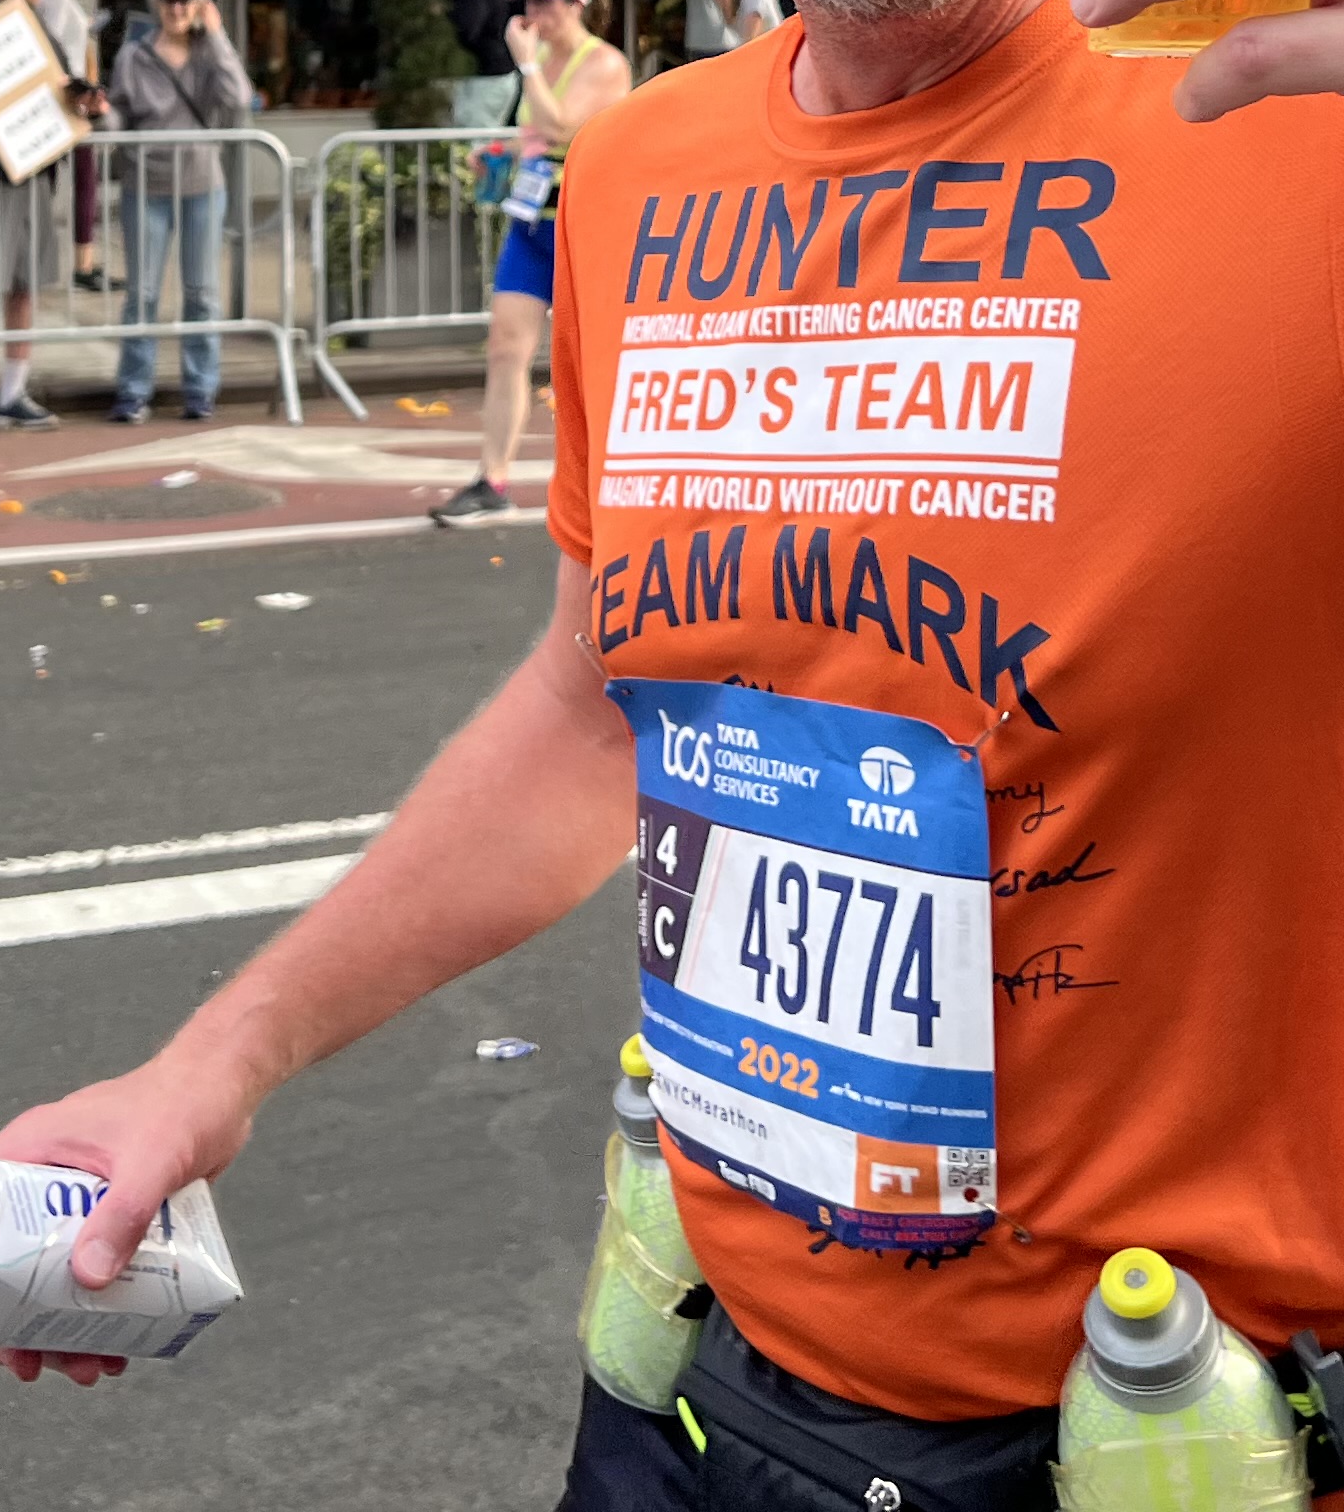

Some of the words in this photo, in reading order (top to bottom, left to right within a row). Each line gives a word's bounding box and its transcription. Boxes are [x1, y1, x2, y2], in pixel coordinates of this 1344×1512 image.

[624, 158, 1116, 304] HUNTER
[622, 313, 694, 345] MEMORIAL
[696, 309, 750, 340] SLOAN
[748, 300, 863, 338] KETTERING
[867, 296, 964, 332] CANCER
[970, 295, 1081, 331] CENTER
[622, 366, 798, 434] FRED'S
[824, 361, 1034, 432] TEAM
[598, 474, 661, 507] IMAGINE
[659, 474, 679, 507] A
[682, 474, 774, 512] WORLD
[778, 477, 905, 514] WITHOUT
[909, 478, 1056, 523] CANCER
[771, 524, 1062, 734] MARK
[716, 722, 760, 750] TATA
[712, 772, 780, 807] SERVICES
[713, 748, 820, 789] CONSULTANCY
[847, 797, 920, 838] TATA
[656, 824, 678, 877] 4
[654, 905, 676, 960] C
[740, 854, 942, 1048] 43774
[738, 1037, 820, 1099] 2022
[869, 1162, 920, 1194] FT
